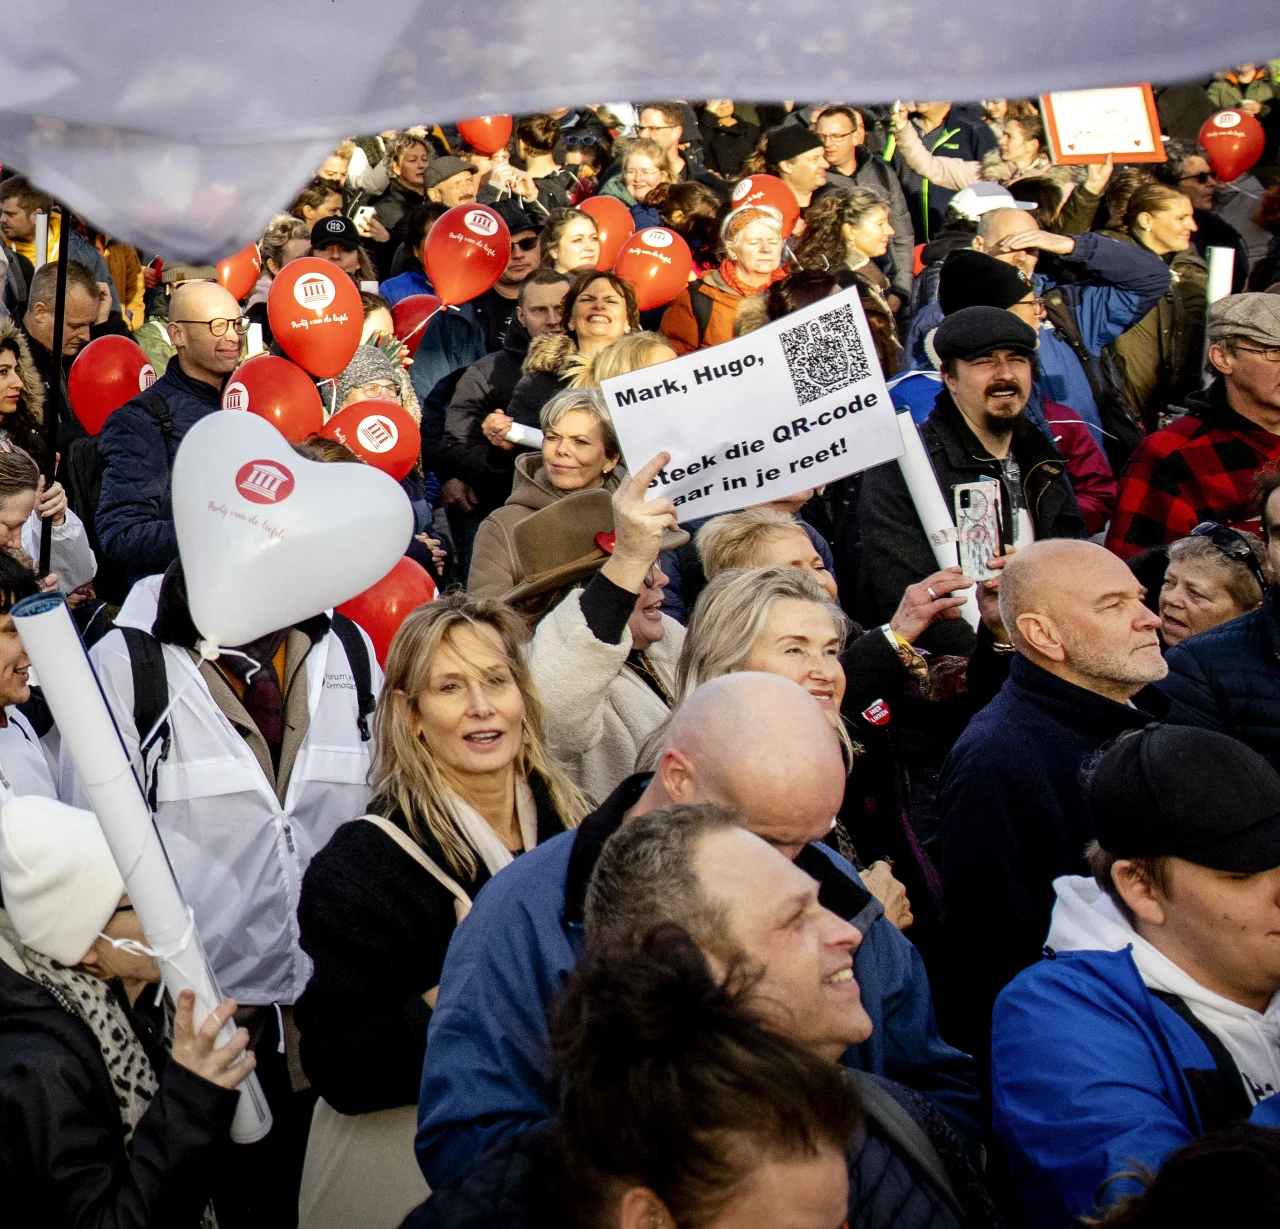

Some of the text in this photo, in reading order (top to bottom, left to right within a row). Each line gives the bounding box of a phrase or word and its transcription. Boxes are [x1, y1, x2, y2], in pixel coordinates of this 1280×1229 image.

[614, 355, 765, 407] Mark, Hugo,
[724, 438, 766, 461] die
[772, 392, 879, 443] QR-code
[672, 437, 849, 507] aar in je reet!
[207, 500, 285, 540] Partij van de liefde
